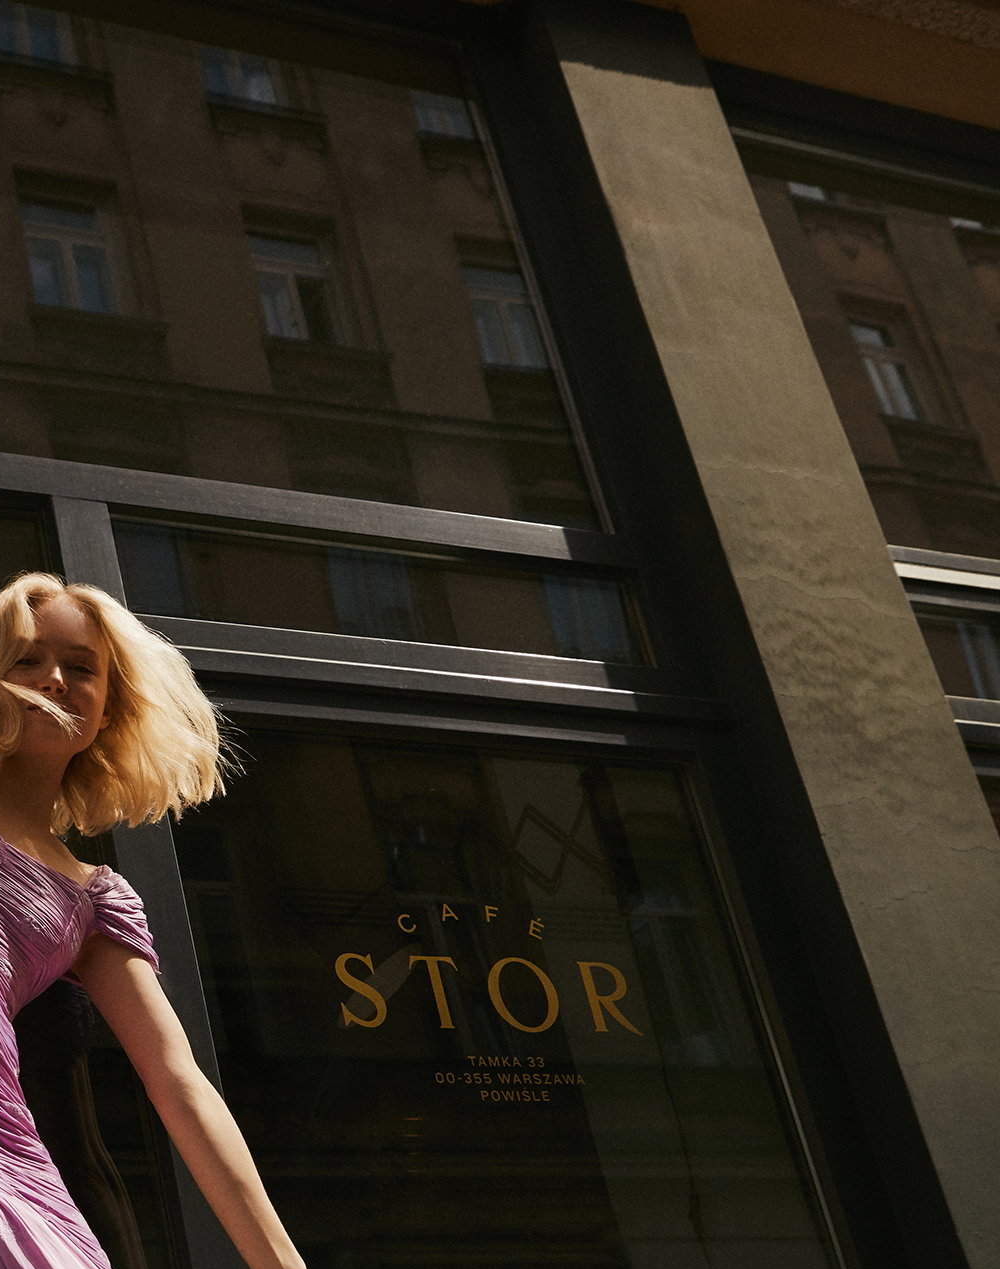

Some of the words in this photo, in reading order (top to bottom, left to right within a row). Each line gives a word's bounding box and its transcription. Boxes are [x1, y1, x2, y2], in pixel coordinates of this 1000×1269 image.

[396, 903, 545, 941] CAFÉ
[334, 952, 645, 1036] STOR
[467, 1055, 522, 1068] TAMKA
[527, 1056, 545, 1068] 33
[434, 1071, 493, 1084] 00-355
[498, 1072, 586, 1085] WARSZAWA
[479, 1086, 551, 1102] POWIŚLE
